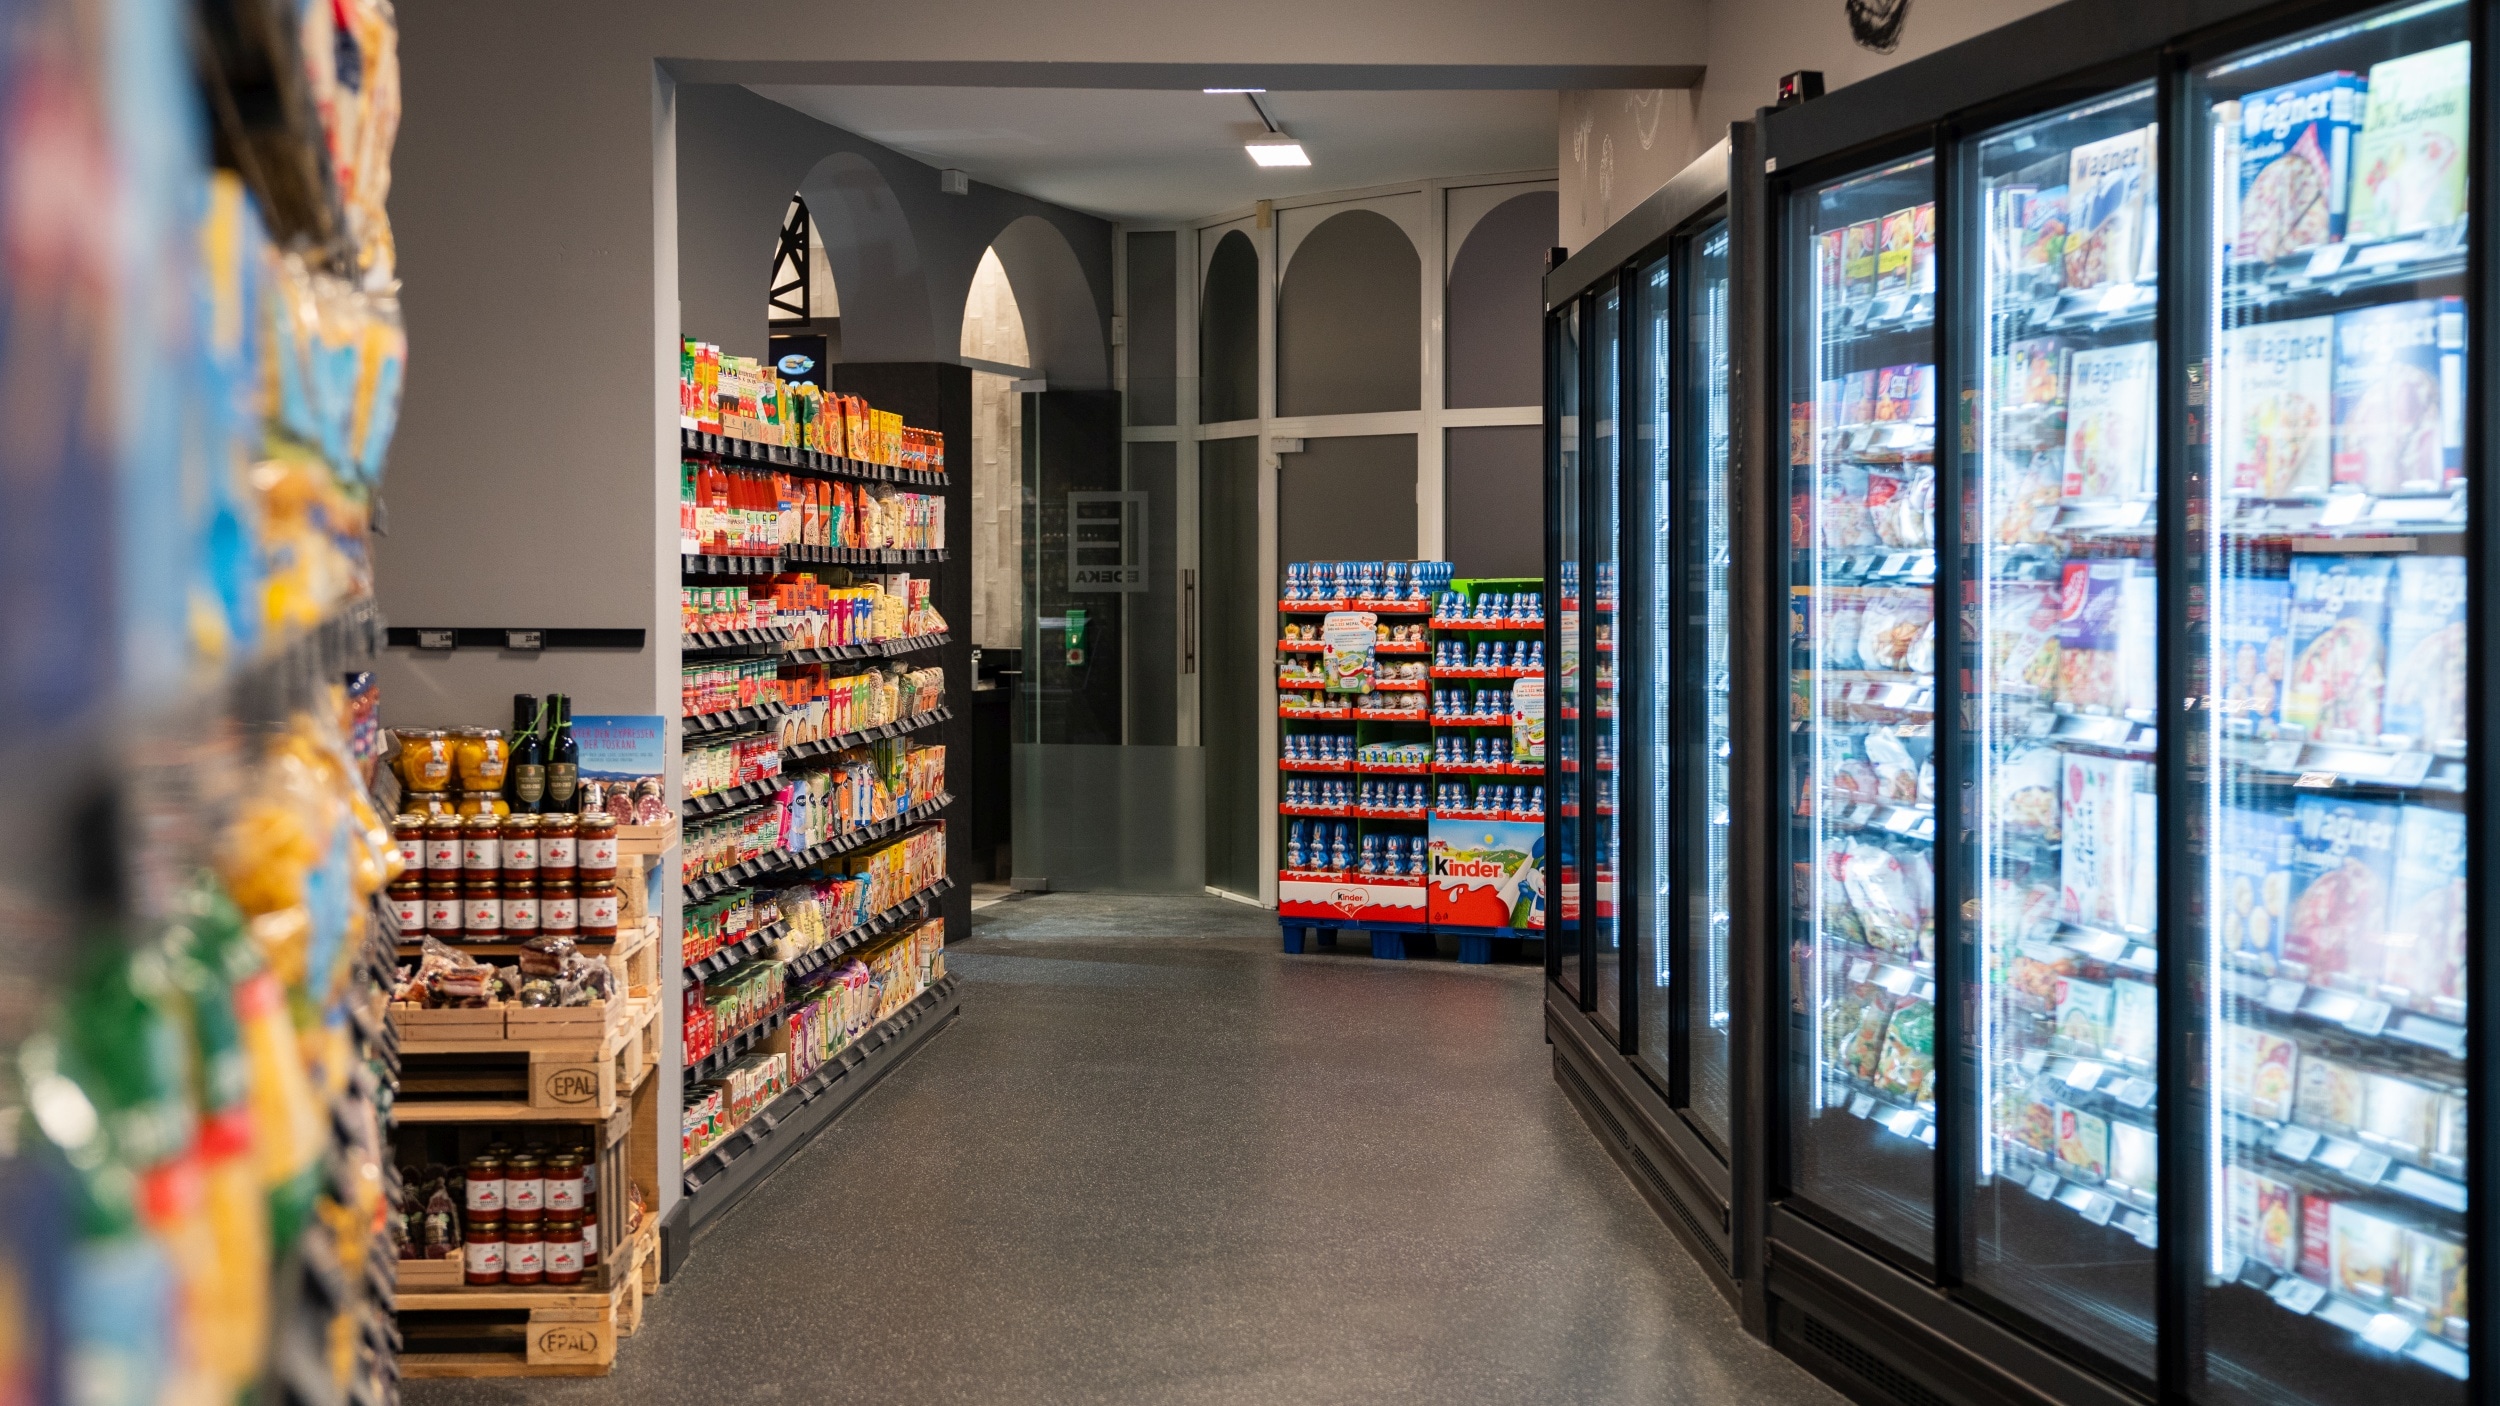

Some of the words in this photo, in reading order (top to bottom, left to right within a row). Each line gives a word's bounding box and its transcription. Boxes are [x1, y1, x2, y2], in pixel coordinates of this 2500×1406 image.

[594, 728, 610, 739] DEN
[613, 728, 655, 739] ZYPRESSEN
[583, 739, 598, 750] DER
[602, 739, 637, 750] TOSKANA
[1435, 855, 1502, 878] Kinder
[1337, 892, 1363, 902] Kinder
[554, 1076, 595, 1097] EPAL
[547, 1334, 590, 1352] EPAL
